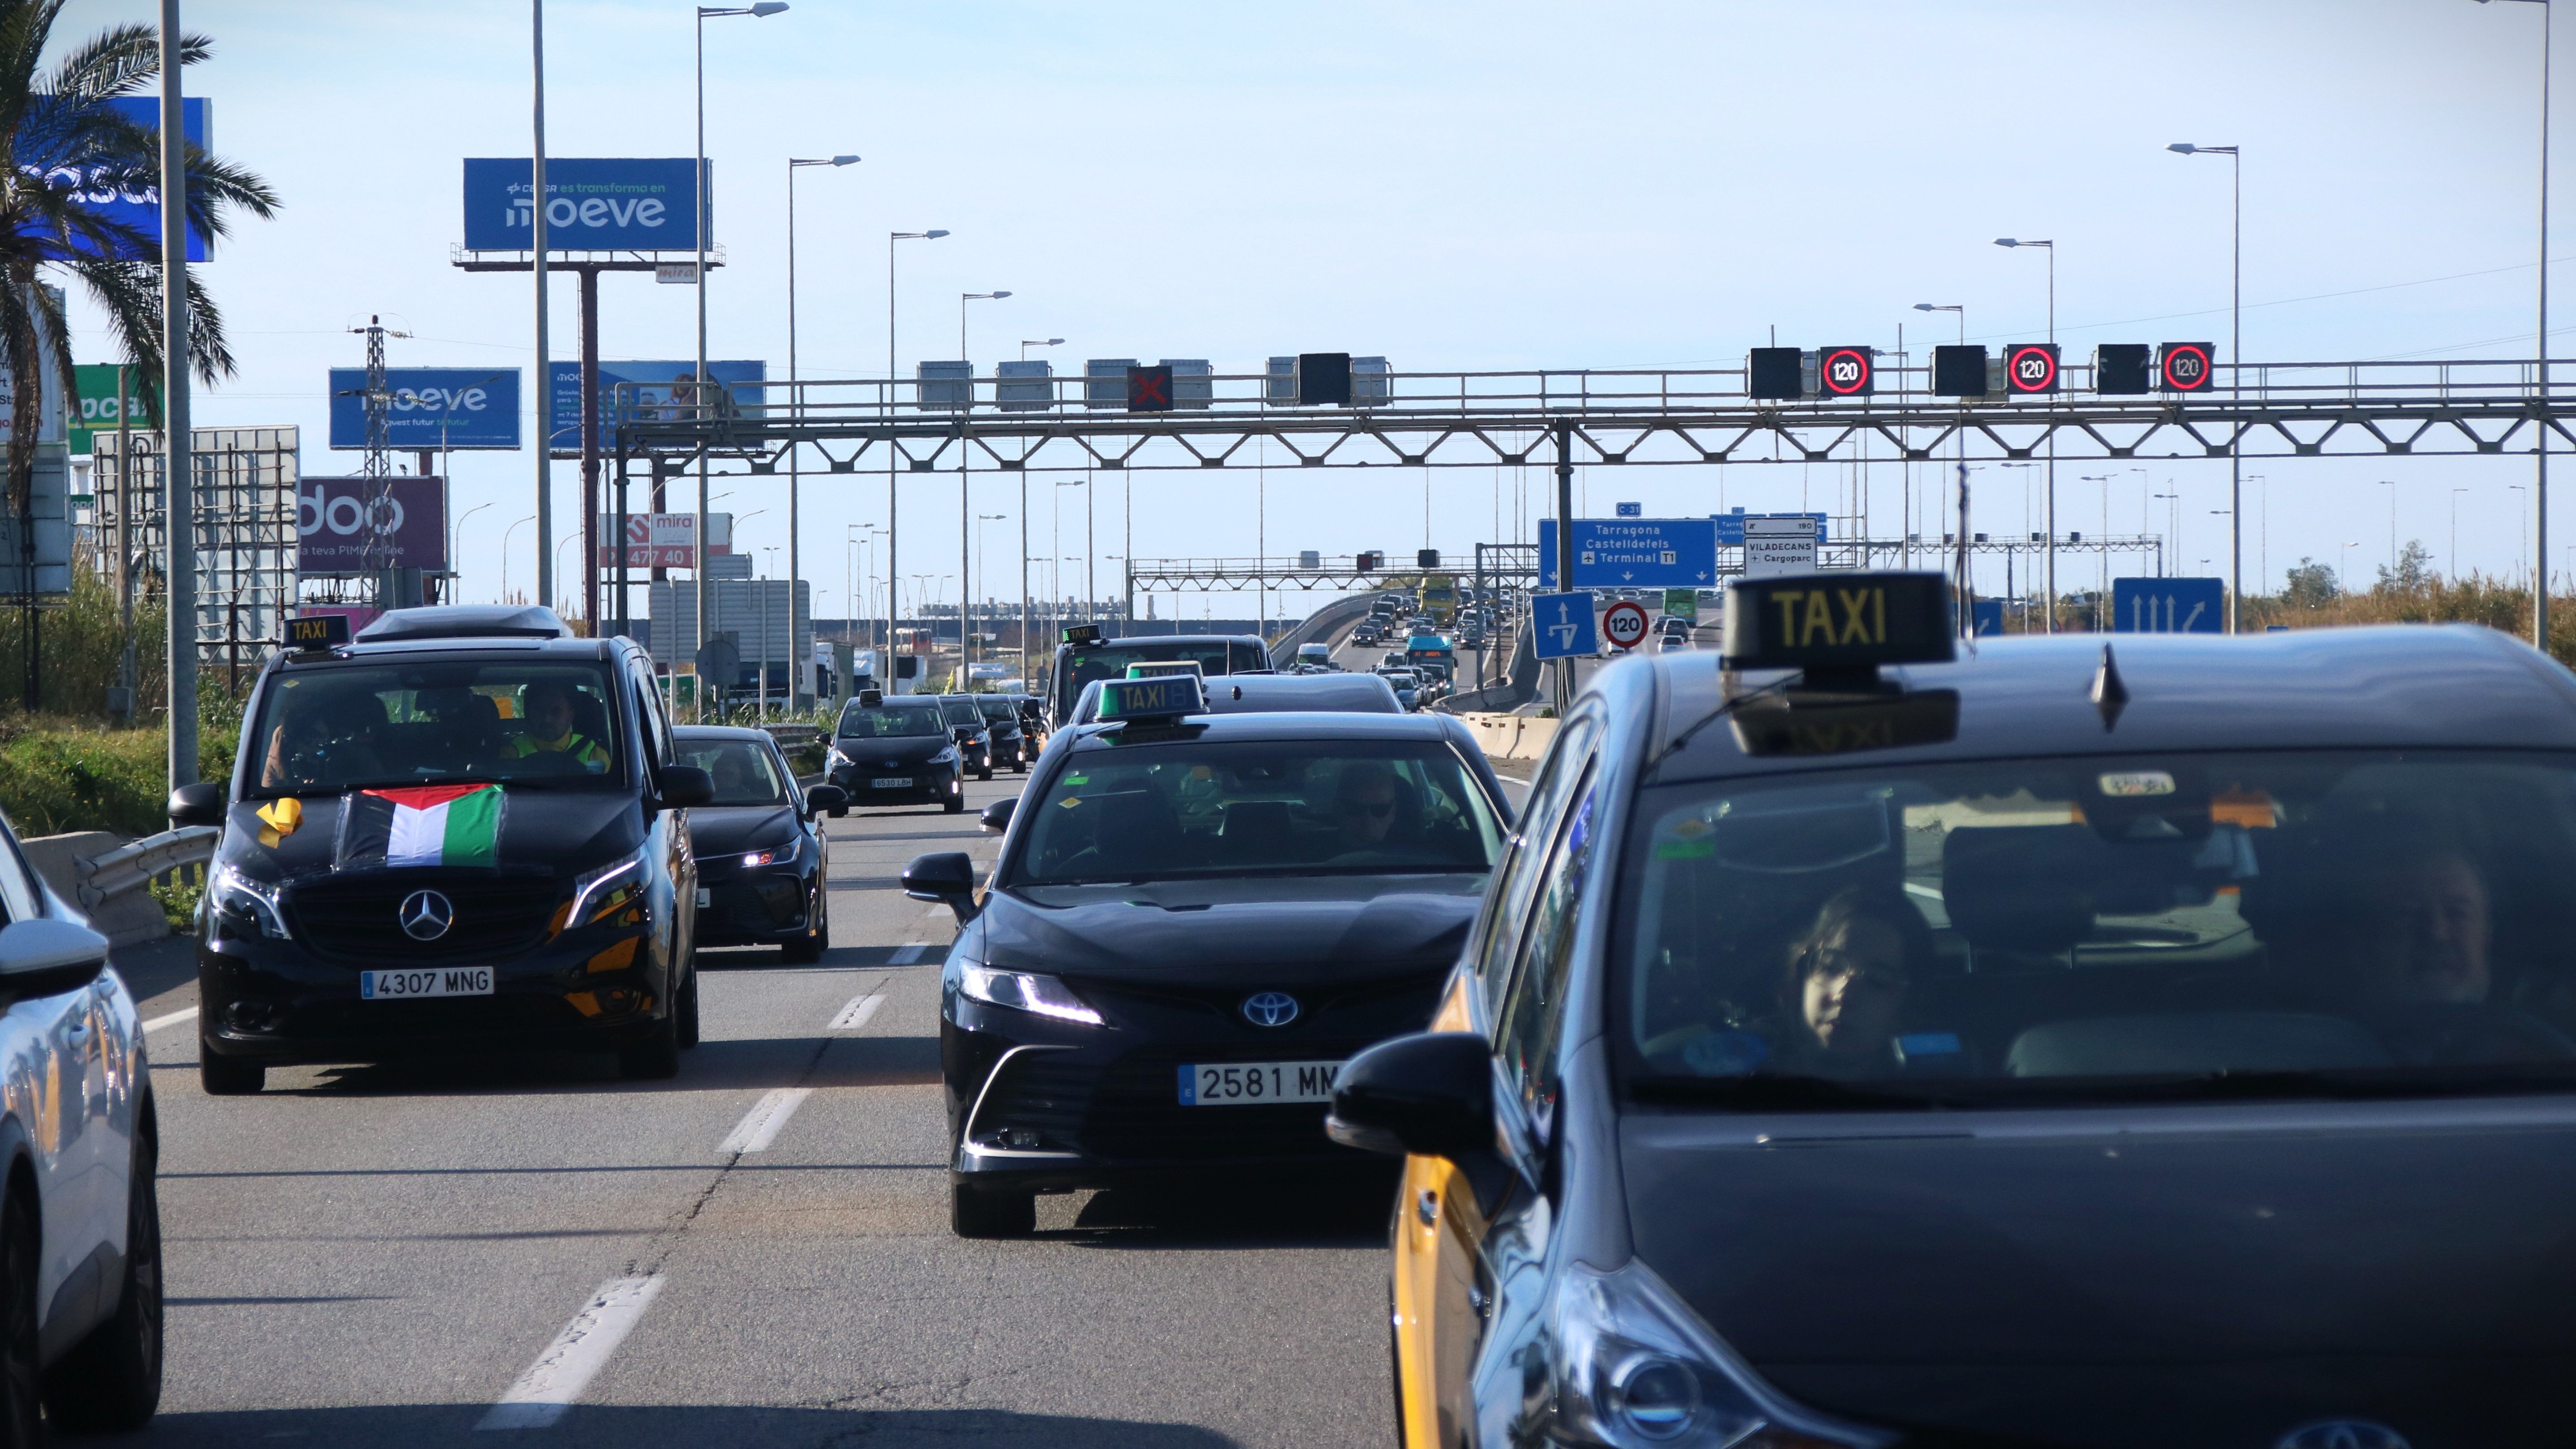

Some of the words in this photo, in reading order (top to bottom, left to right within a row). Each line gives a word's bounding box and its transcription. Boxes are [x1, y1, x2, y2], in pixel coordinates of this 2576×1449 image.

[560, 184, 574, 192] es
[577, 183, 647, 192] transforma
[650, 184, 666, 192] en
[506, 197, 666, 227] moeve
[1833, 362, 1858, 381] 120
[2019, 360, 2045, 378] 120
[2175, 359, 2199, 376] 120
[656, 516, 692, 528] mira
[1595, 525, 1660, 537] Tarragona
[312, 546, 335, 555] teva
[1586, 539, 1669, 549] Castelldefels
[664, 550, 684, 564] 40
[1600, 553, 1656, 563] Terminal
[1663, 553, 1674, 563] T1
[1764, 555, 1811, 563] Cargoparc
[1611, 617, 1640, 632] 120
[1772, 588, 1886, 647] TAXI
[293, 620, 327, 640] TAXI
[1070, 628, 1090, 639] TAXI
[1123, 684, 1166, 710] TAXI
[379, 973, 436, 995] 4307
[445, 971, 489, 992] MNG
[1185, 1089, 1192, 1097] E
[1203, 1067, 1280, 1099] 2581
[1299, 1066, 1338, 1096] MM
